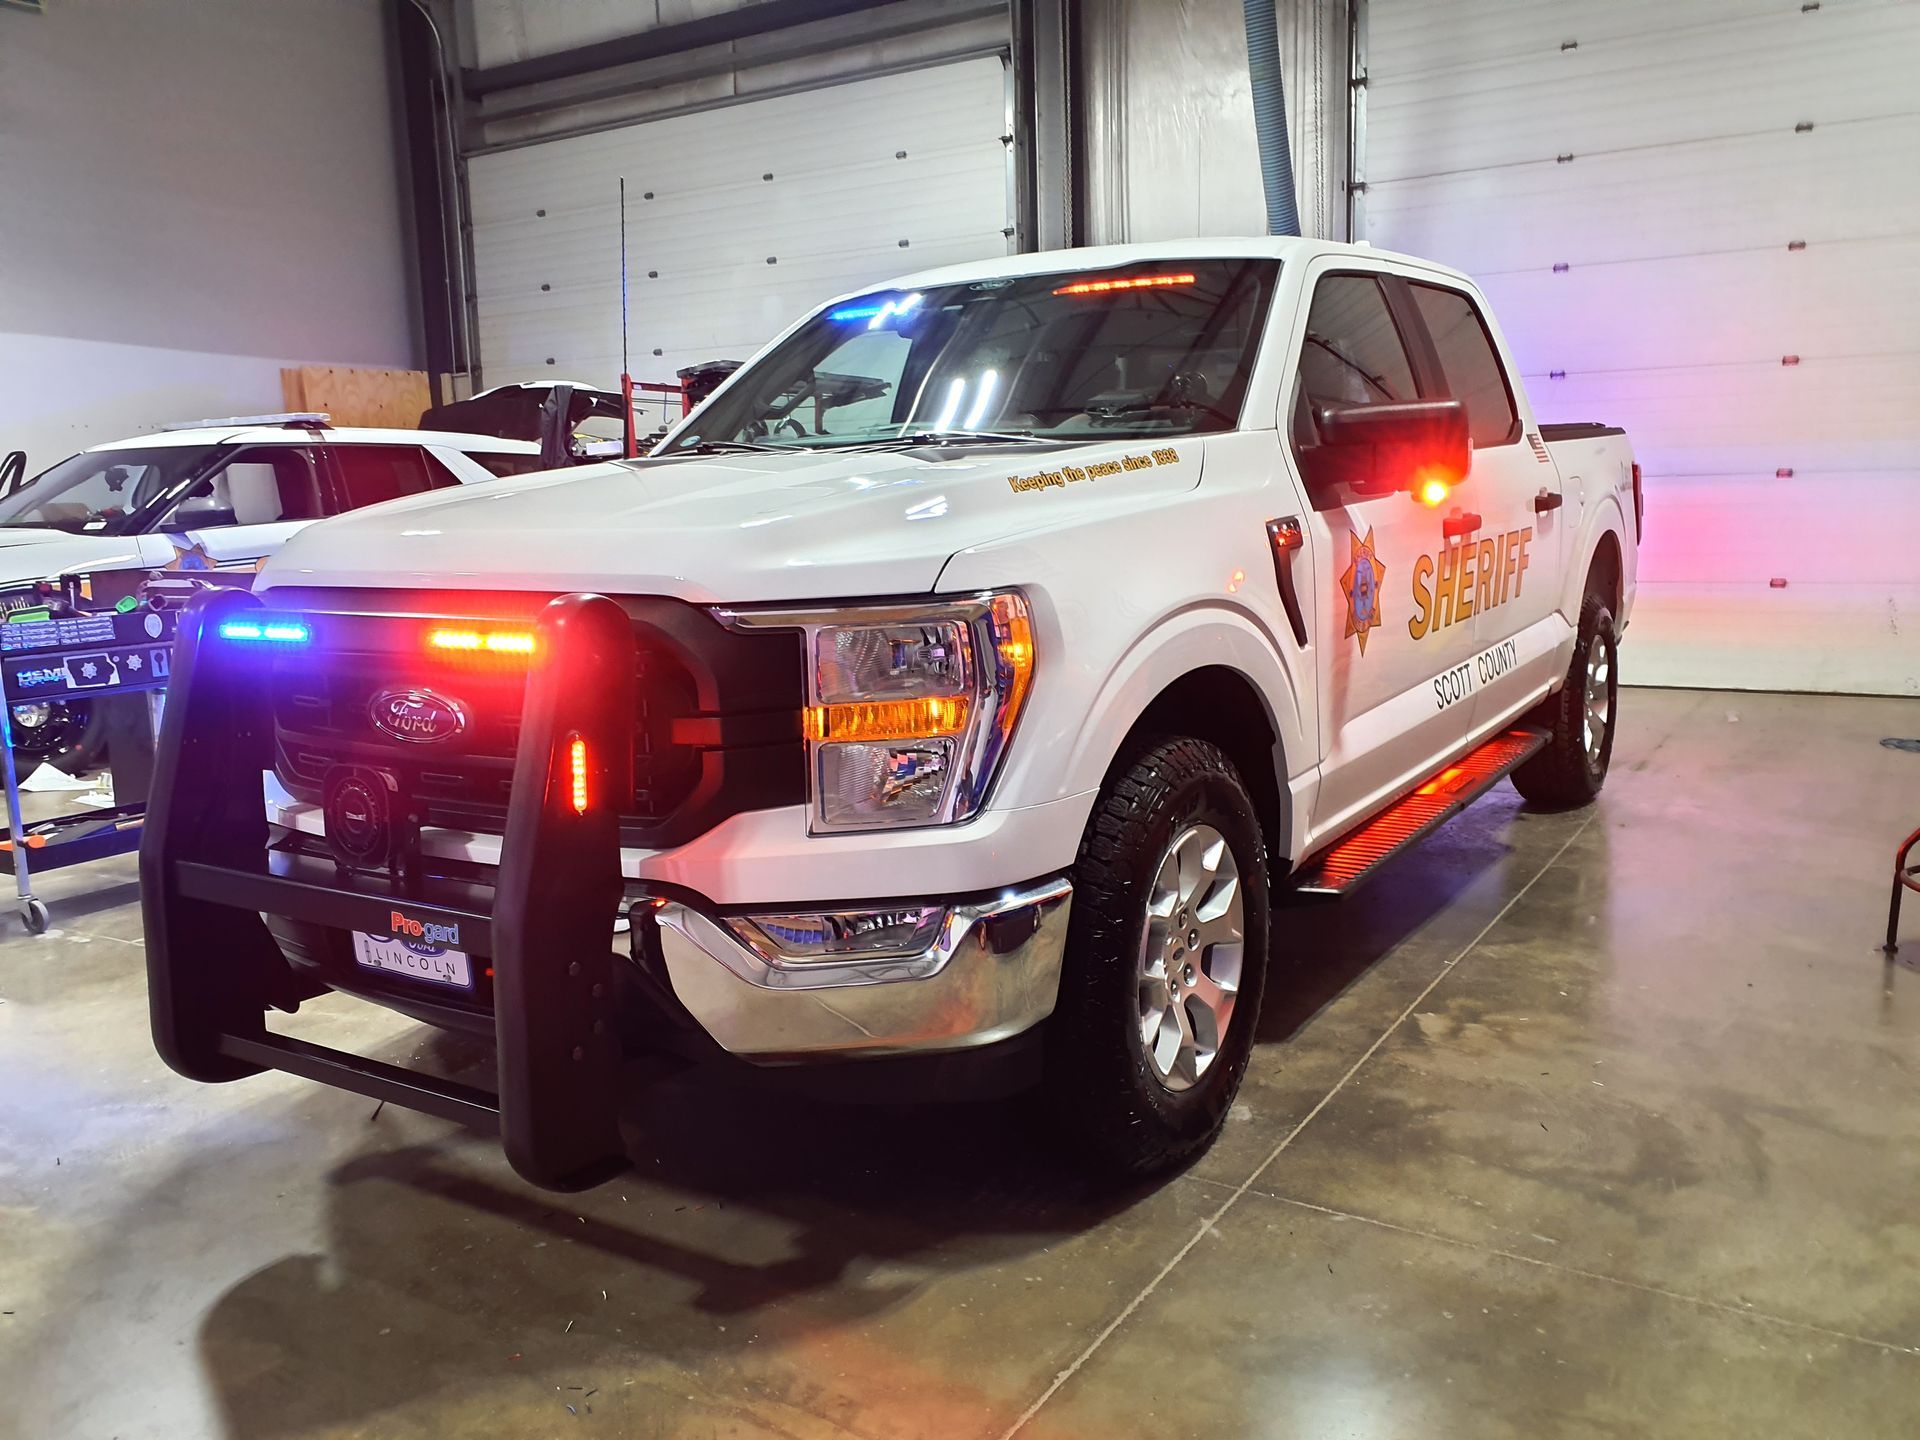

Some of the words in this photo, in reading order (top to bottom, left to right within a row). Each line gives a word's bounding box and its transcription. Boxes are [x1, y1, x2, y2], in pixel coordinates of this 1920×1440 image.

[1008, 471, 1065, 493] Keeping
[1062, 467, 1085, 482] the
[1085, 460, 1122, 481] peace
[1121, 455, 1153, 472] since
[1152, 448, 1179, 465] 1838
[1408, 526, 1533, 641] SHERIFF
[1433, 663, 1472, 710] SCOTT
[1477, 639, 1518, 685] COUNTY
[387, 699, 437, 733] Ford
[375, 948, 456, 976] LINCOLN
